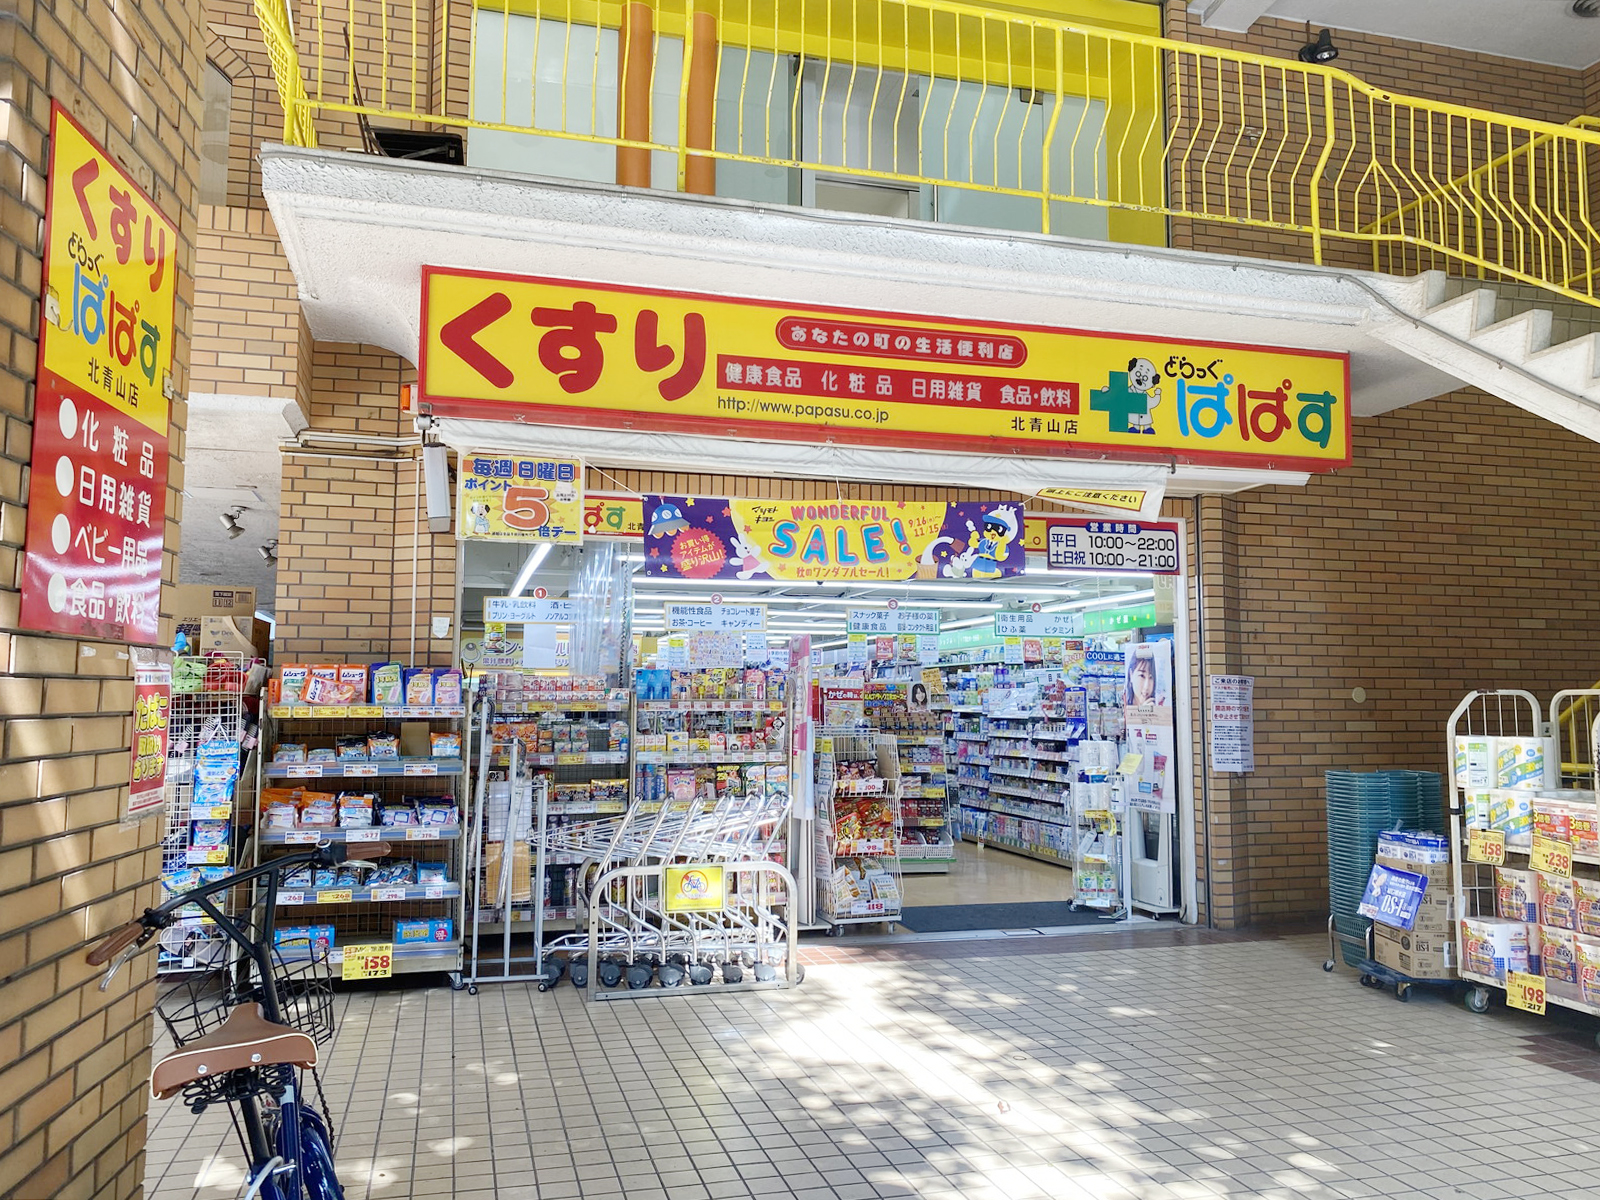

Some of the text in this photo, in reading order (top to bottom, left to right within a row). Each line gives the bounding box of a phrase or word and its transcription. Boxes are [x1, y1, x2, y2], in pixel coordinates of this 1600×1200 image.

[71, 158, 166, 292] くすり
[67, 231, 104, 277] どらっぐ
[72, 262, 161, 387] ぱぱす
[439, 291, 707, 402] くすり
[790, 325, 1014, 361] あなたの町の生活便利店
[1163, 355, 1224, 380] どらっぐ
[87, 356, 139, 409] 北青山店
[725, 361, 1072, 409] 健康食品 化粧品 日用雑貨 食品・飲料
[717, 395, 889, 423] http://www.papasu.co.jp
[1176, 373, 1337, 449] ぱぱす
[1010, 416, 1078, 435] 北青山店
[81, 408, 154, 479] 化粧品
[472, 458, 575, 481] 毎週 日曜日
[79, 464, 152, 528] 日用雑貨
[464, 478, 512, 491] ポイント
[502, 485, 550, 531] 5
[790, 504, 890, 522] WONDERFUL
[538, 525, 577, 538] 倍デー
[1089, 522, 1137, 534] 営業時間
[74, 524, 149, 578] ベビー用品
[1051, 534, 1077, 548] 平日
[1051, 551, 1086, 566] 土日祝
[796, 566, 890, 578] 秋のワンダフルセール!
[672, 606, 713, 616] 機能性食品
[852, 611, 890, 619] スナック菓子
[134, 692, 168, 733] たばこ
[1483, 841, 1502, 856] 158
[1548, 852, 1569, 869] 238
[364, 955, 390, 970] 158
[1523, 985, 1544, 1004] 198
[1527, 1003, 1542, 1011] 217
